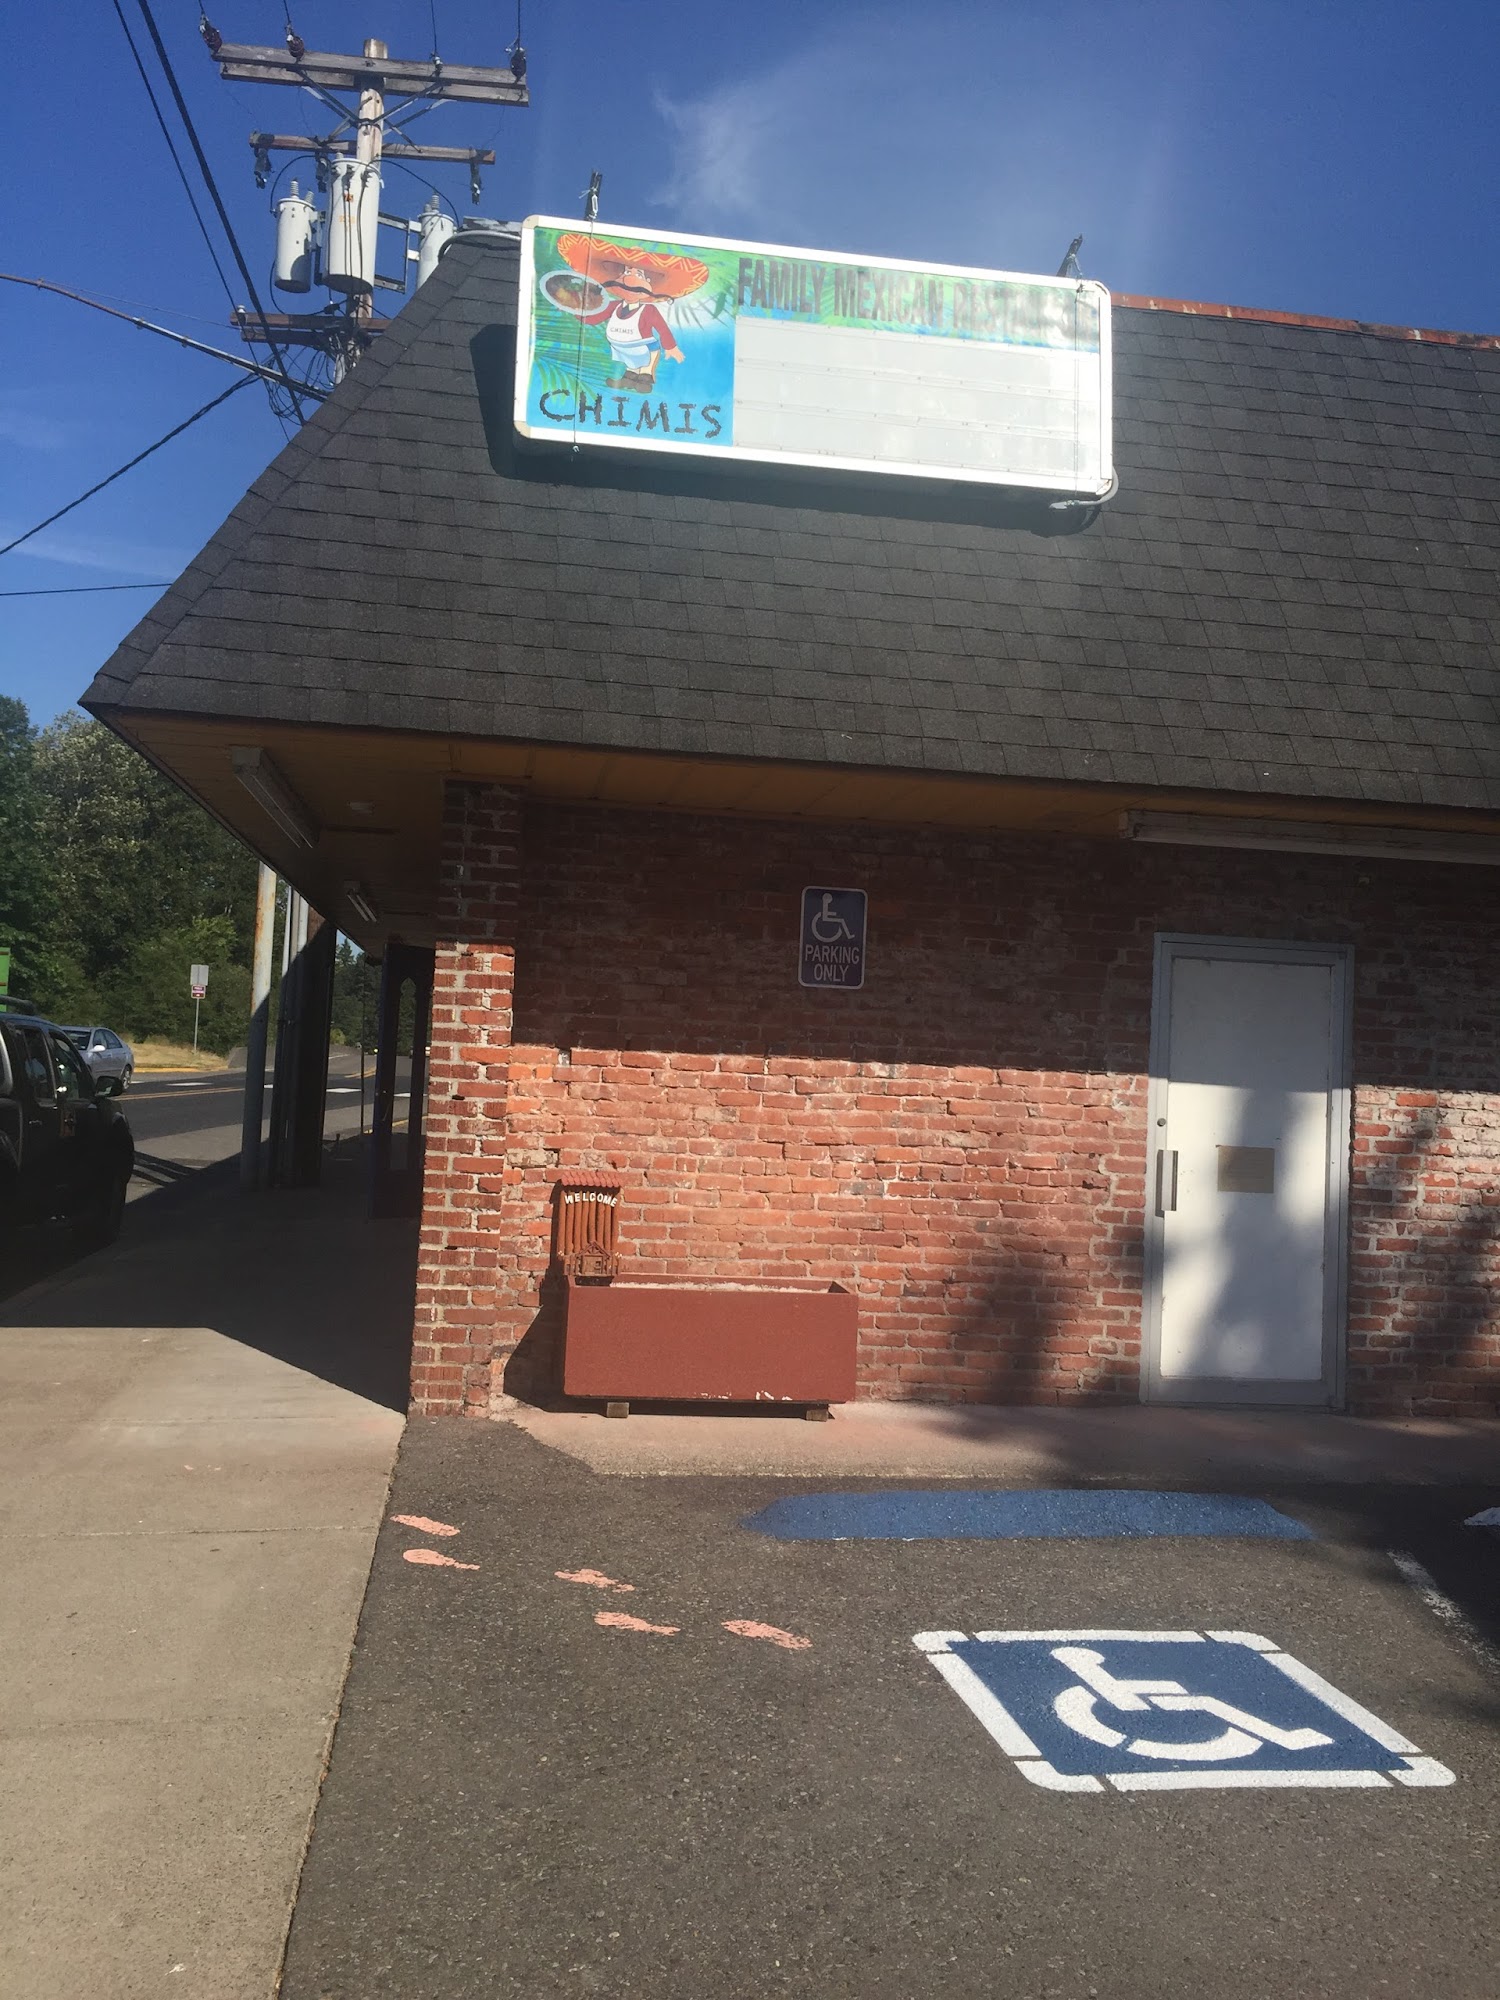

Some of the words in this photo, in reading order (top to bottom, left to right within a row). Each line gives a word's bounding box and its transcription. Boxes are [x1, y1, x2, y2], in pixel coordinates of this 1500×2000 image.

[738, 257, 826, 314] FAMILY
[834, 266, 945, 328] MEXICAN
[610, 327, 634, 335] CHIMIS
[539, 389, 722, 439] CHIMIS
[805, 944, 860, 964] PARKING
[814, 963, 849, 982] ONLY
[564, 1192, 617, 1207] WELCOME
